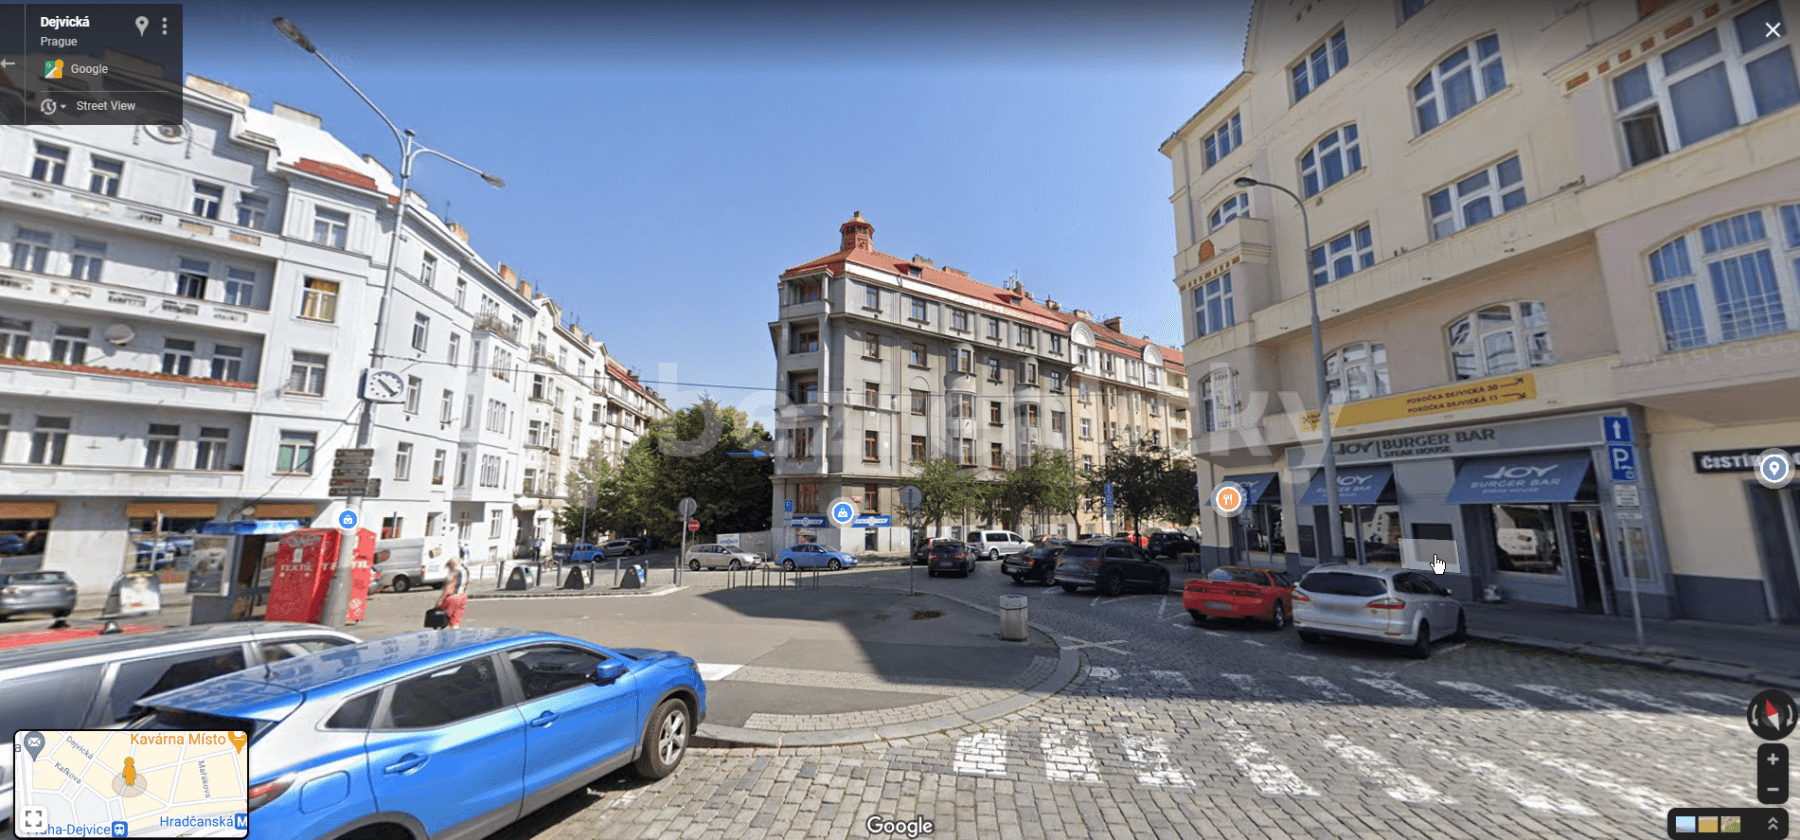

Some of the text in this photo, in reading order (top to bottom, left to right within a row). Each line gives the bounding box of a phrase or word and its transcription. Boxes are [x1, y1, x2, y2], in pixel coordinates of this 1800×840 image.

[1382, 428, 1496, 450] BURGER BAR
[1334, 441, 1374, 455] JOY
[1383, 445, 1451, 458] STEAK HOUSE
[1613, 447, 1629, 470] P
[1482, 464, 1559, 479] JOY
[1336, 474, 1374, 486] OY
[1470, 478, 1561, 489] BURGER BAR
